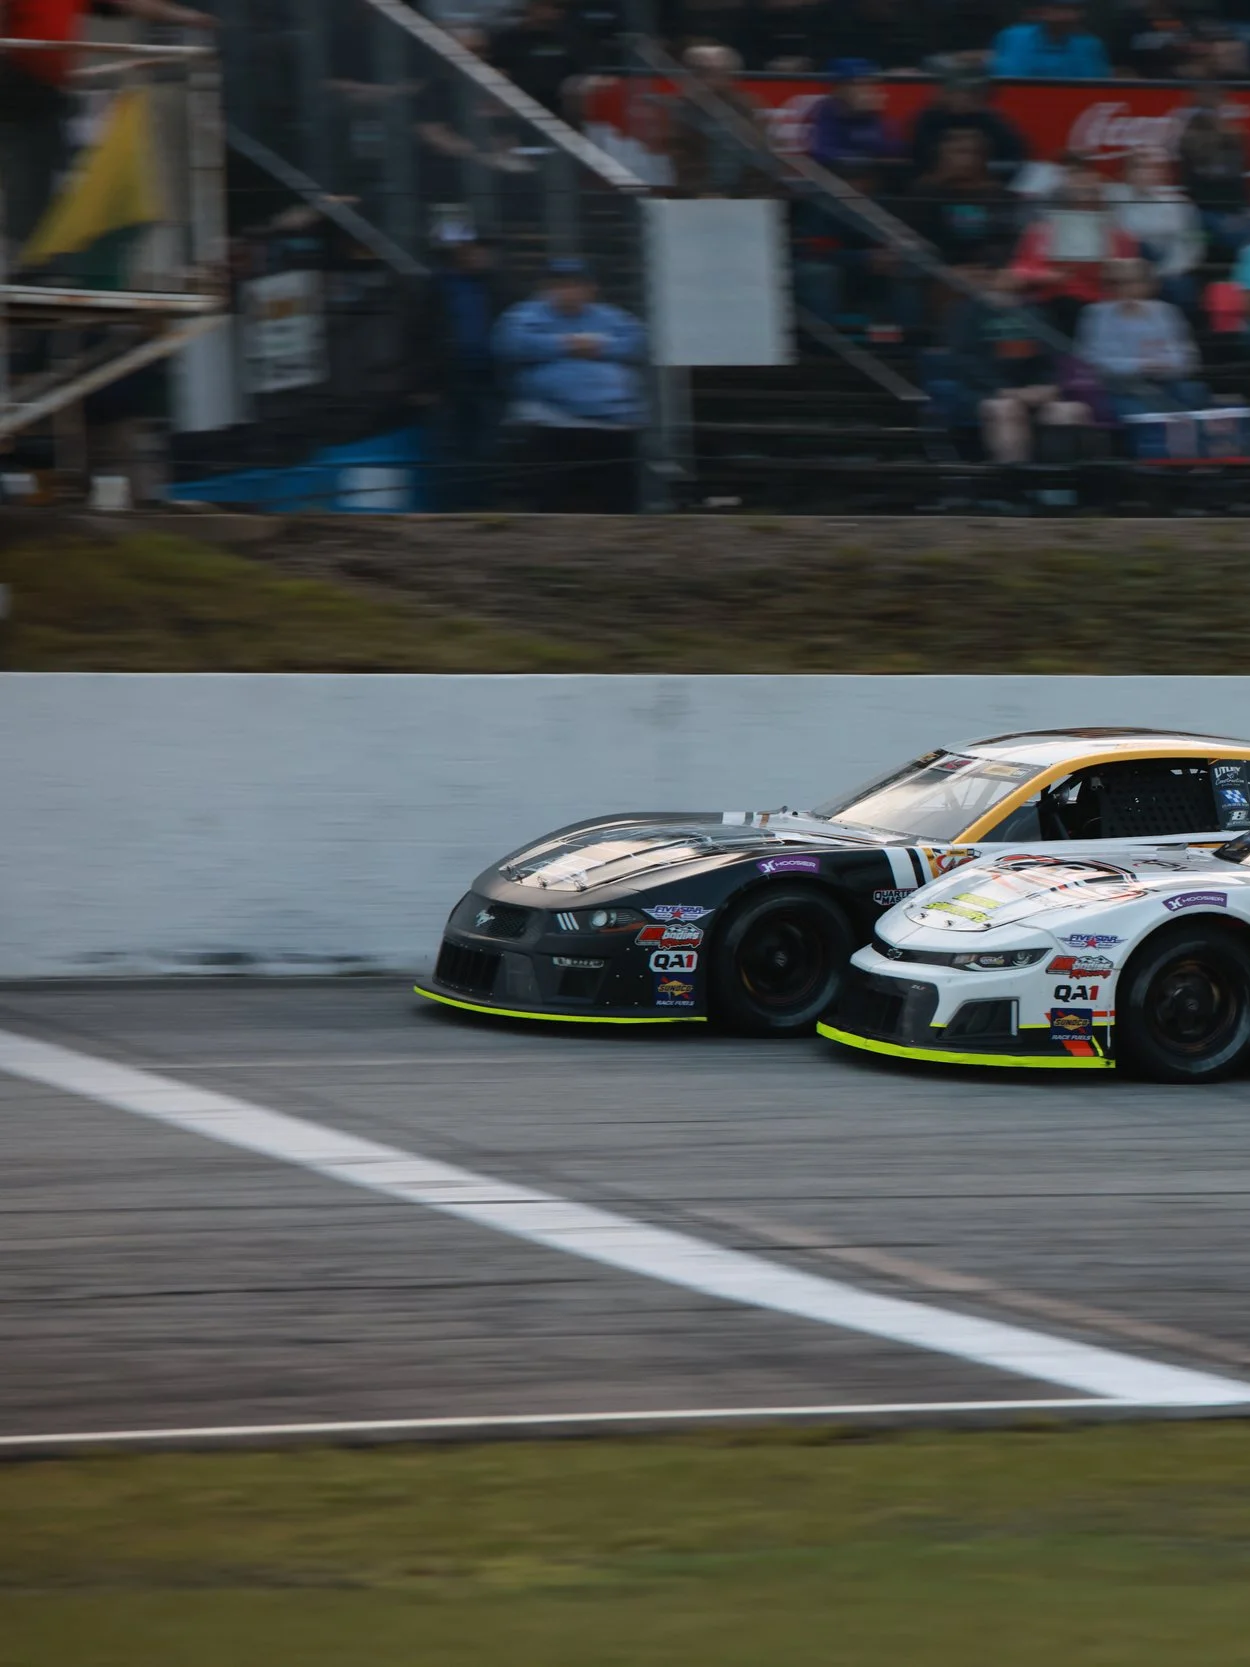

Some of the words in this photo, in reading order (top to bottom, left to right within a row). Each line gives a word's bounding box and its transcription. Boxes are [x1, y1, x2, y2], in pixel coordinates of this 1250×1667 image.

[1214, 766, 1242, 779] UTLEY
[773, 860, 817, 869] HOOSIER
[874, 890, 915, 901] QUARTE
[1181, 895, 1225, 904] HOOSIER
[655, 905, 678, 914] FIVE
[680, 905, 703, 914] STAR
[1070, 934, 1092, 943] FIVE
[1095, 935, 1118, 943] STAR
[654, 953, 694, 970] QA1
[658, 983, 693, 993] SUNOCO
[1054, 984, 1099, 1002] QA1
[1054, 1017, 1090, 1027] SUNOCO
